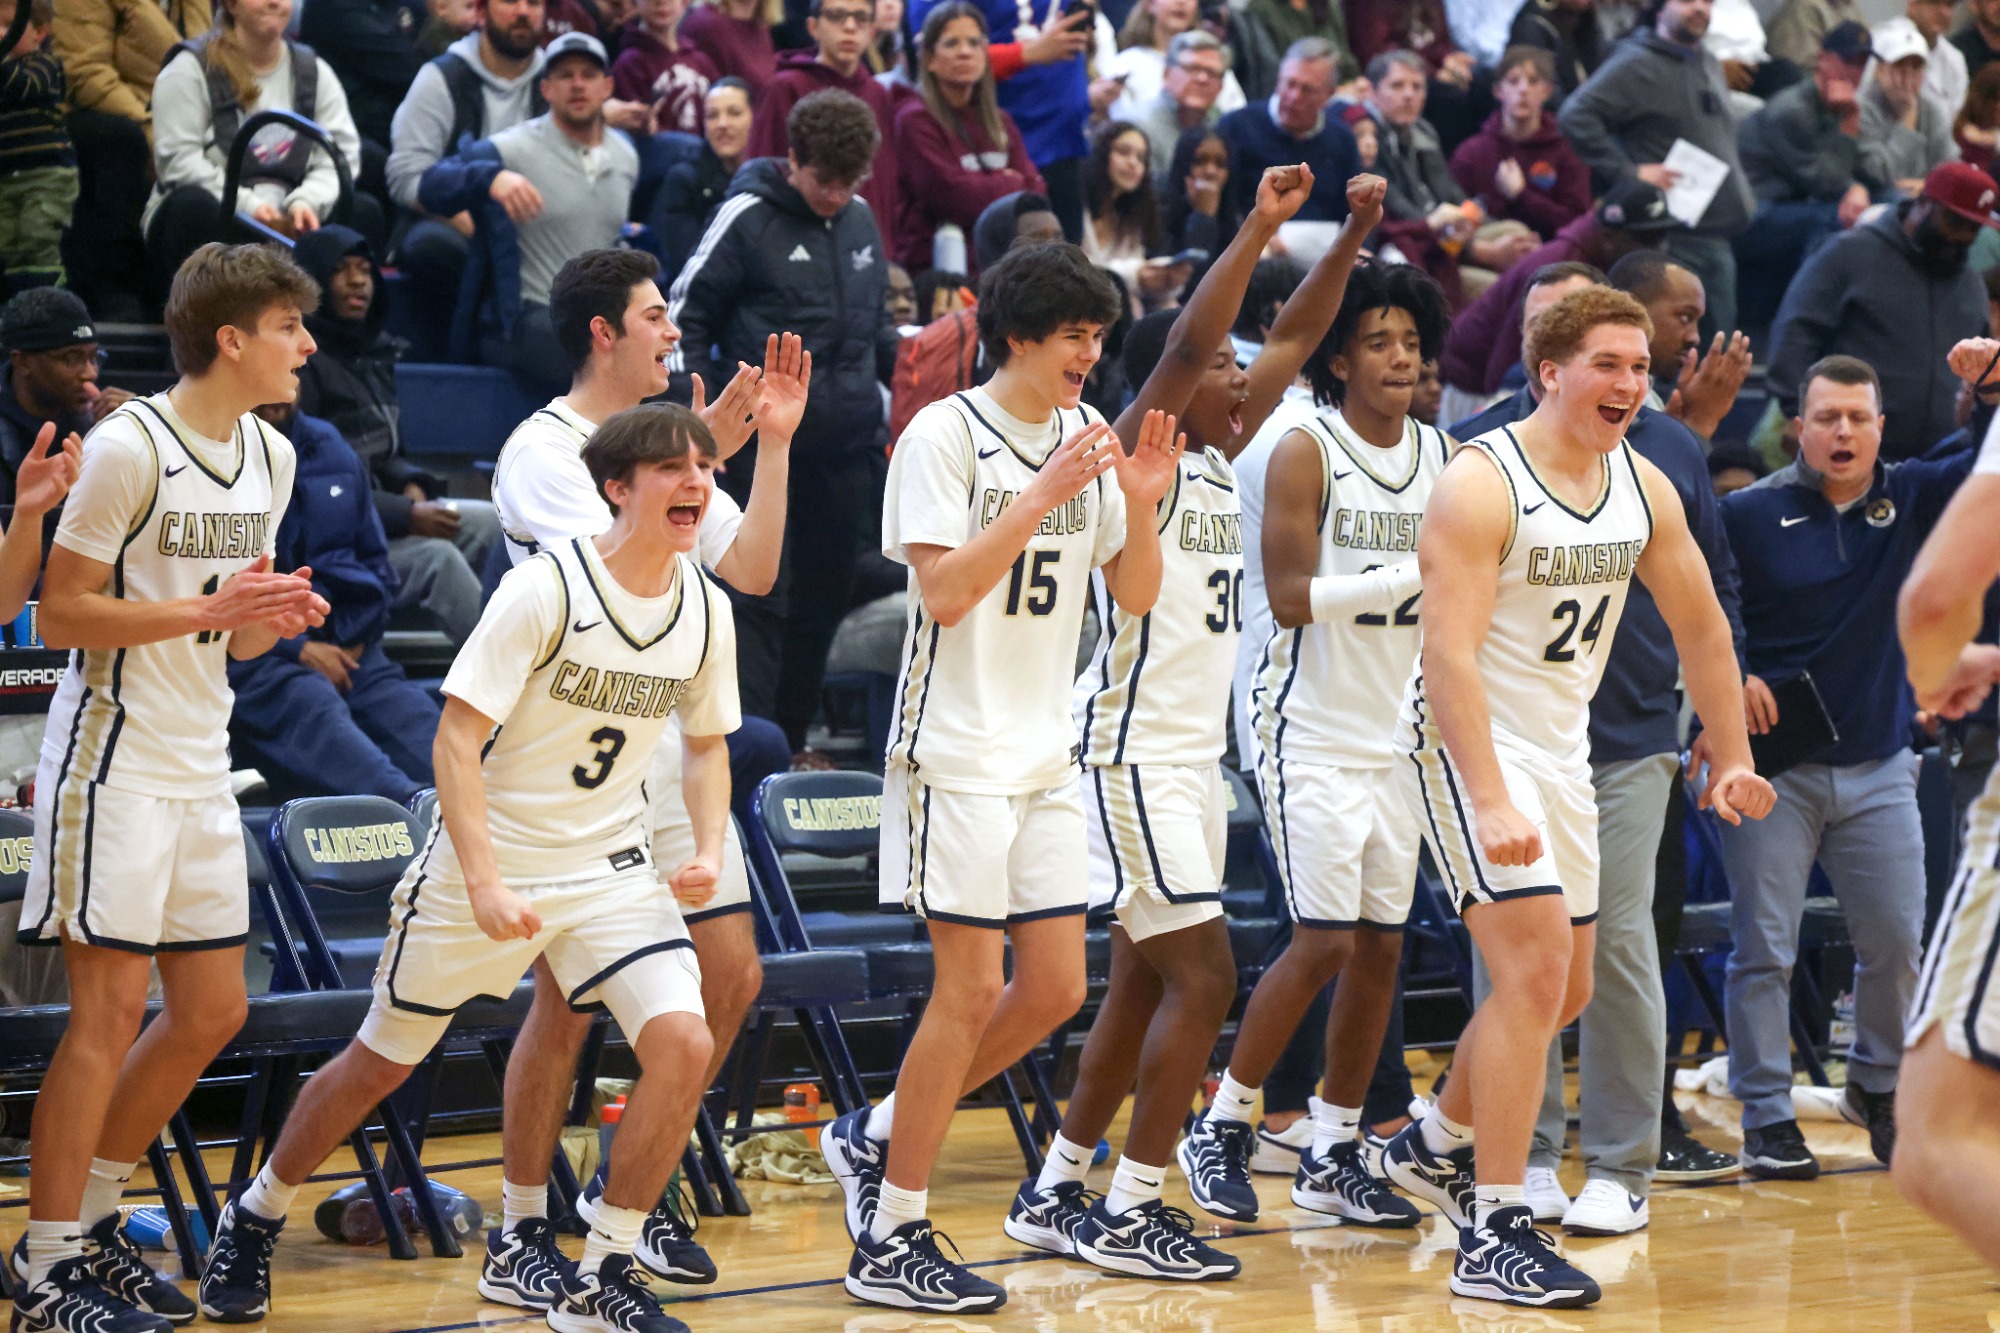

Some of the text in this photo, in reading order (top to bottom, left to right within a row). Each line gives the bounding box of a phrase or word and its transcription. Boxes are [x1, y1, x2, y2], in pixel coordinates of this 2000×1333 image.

[1002, 549, 1062, 618] 15
[1543, 594, 1611, 663] 24
[571, 726, 627, 790] 3
[303, 821, 414, 863] CANISIUS
